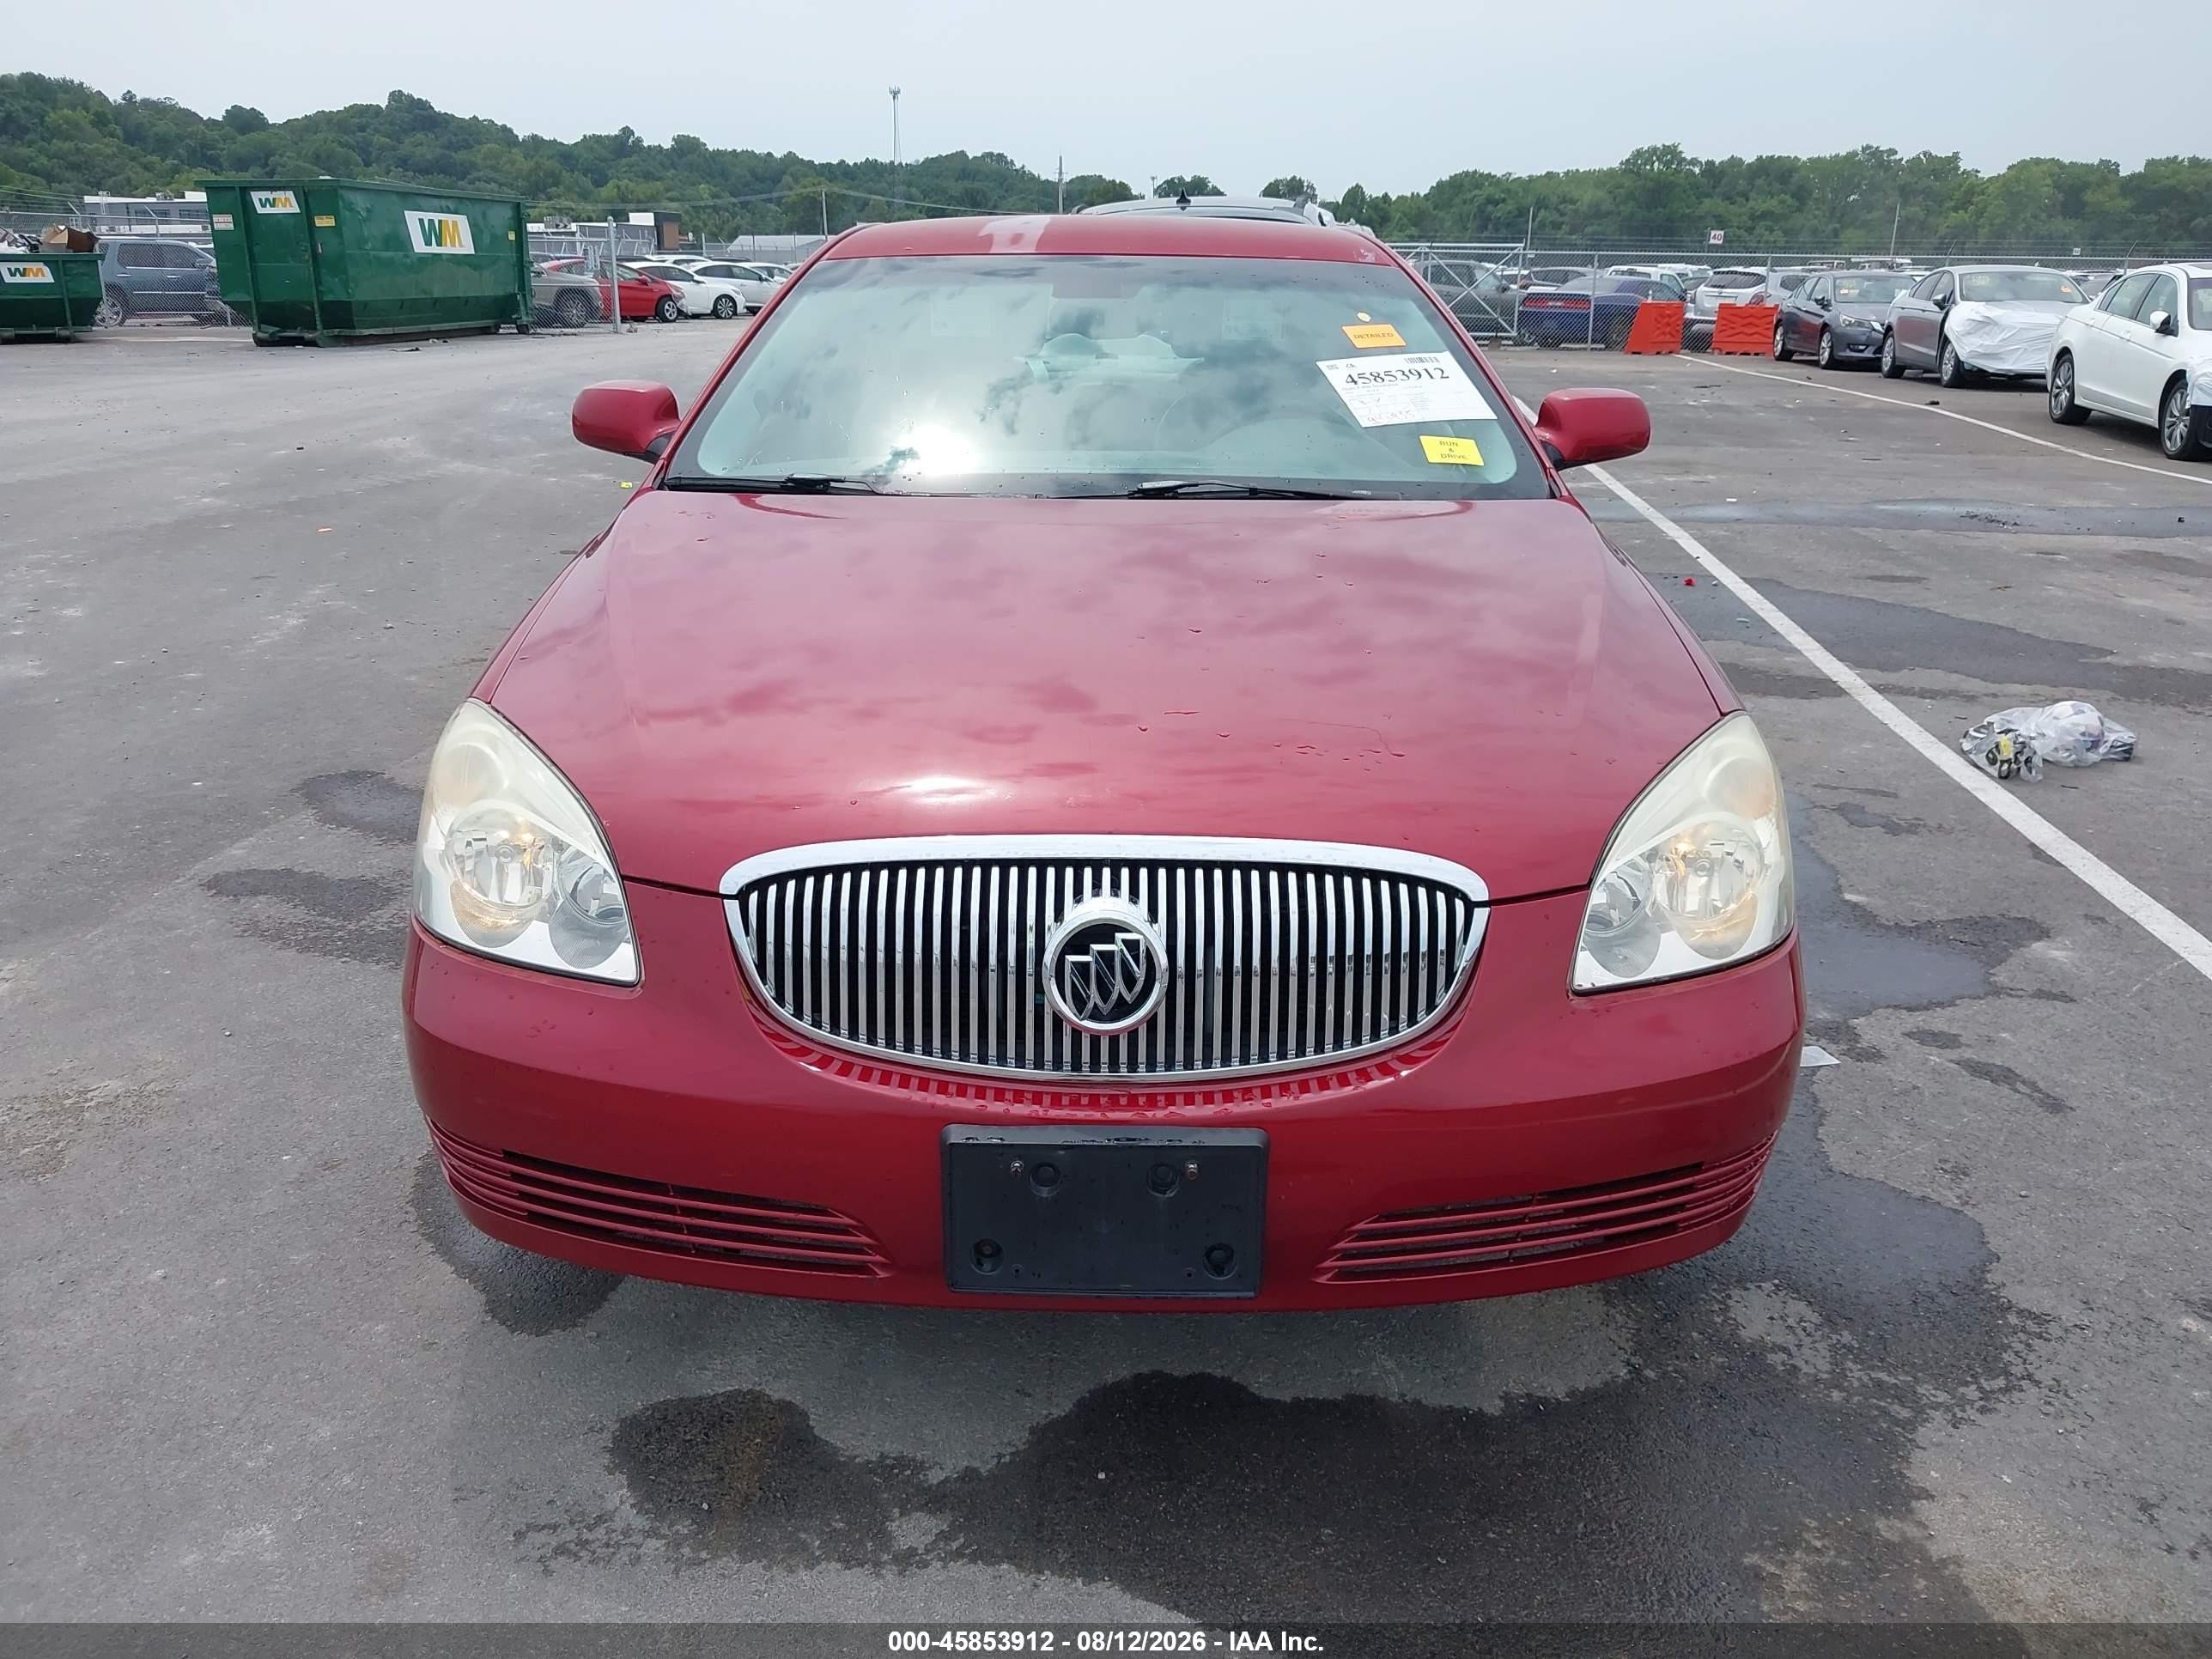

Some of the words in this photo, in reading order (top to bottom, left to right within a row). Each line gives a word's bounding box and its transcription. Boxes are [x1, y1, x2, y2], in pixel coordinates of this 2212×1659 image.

[258, 197, 294, 209] WM
[417, 217, 465, 248] WM
[1711, 233, 1723, 241] 40
[7, 267, 46, 277] WM
[1346, 367, 1449, 386] 45853912
